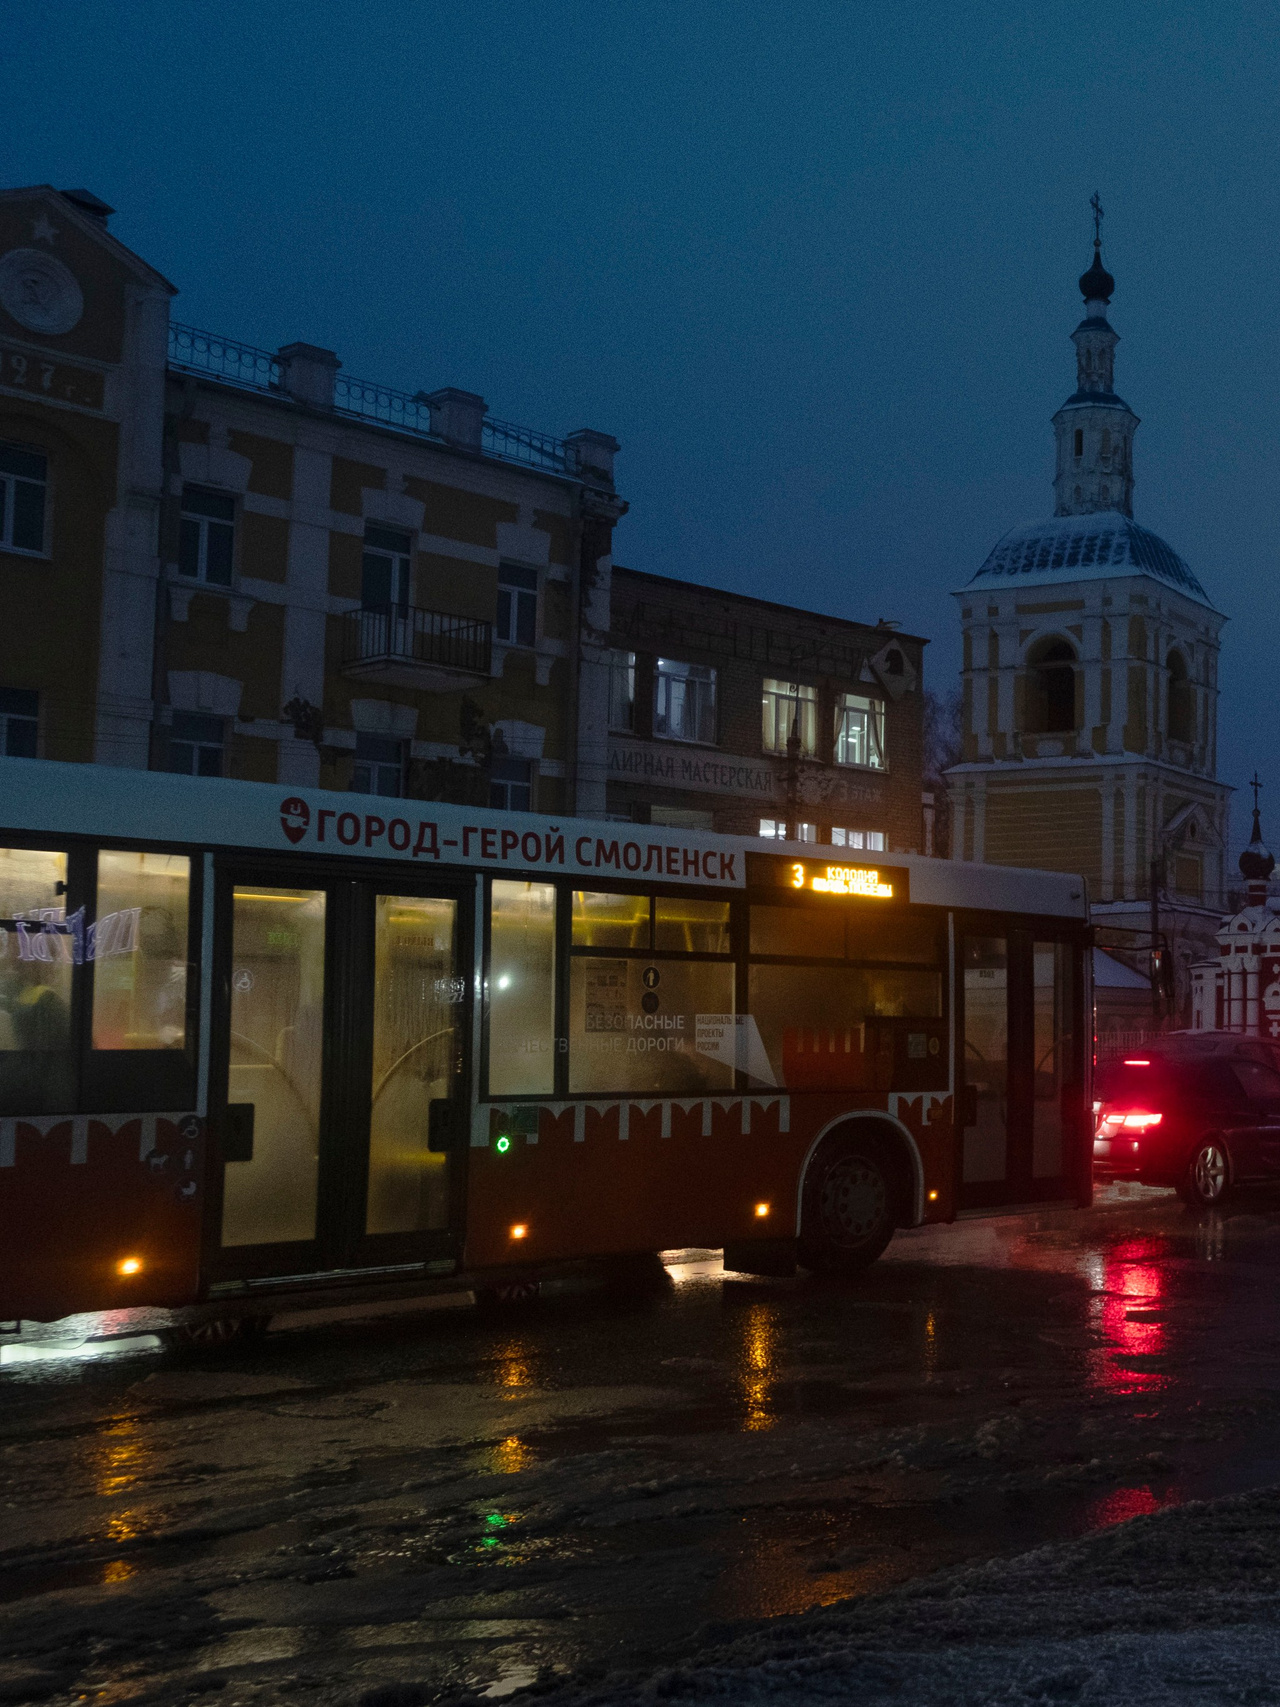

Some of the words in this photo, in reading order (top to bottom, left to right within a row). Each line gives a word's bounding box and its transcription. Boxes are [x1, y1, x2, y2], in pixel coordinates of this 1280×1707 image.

[681, 757, 773, 792] МАСТЕРСКАЯ
[839, 780, 848, 802] 3
[851, 783, 883, 804] ЭТАЖ
[317, 809, 565, 864] ГОРОД-ГЕРОЙ
[575, 837, 737, 880] СМОЛЕНСК
[792, 864, 804, 888] 3
[826, 866, 879, 884] КОЛОДНЯ
[585, 1014, 685, 1030] БЕЗОПАСНЫЕ
[697, 1015, 745, 1025] НАЦИОНАЛЬЫЕ
[697, 1028, 724, 1038] ПРОЕКТЫ
[626, 1037, 685, 1055] ДОРОГИ
